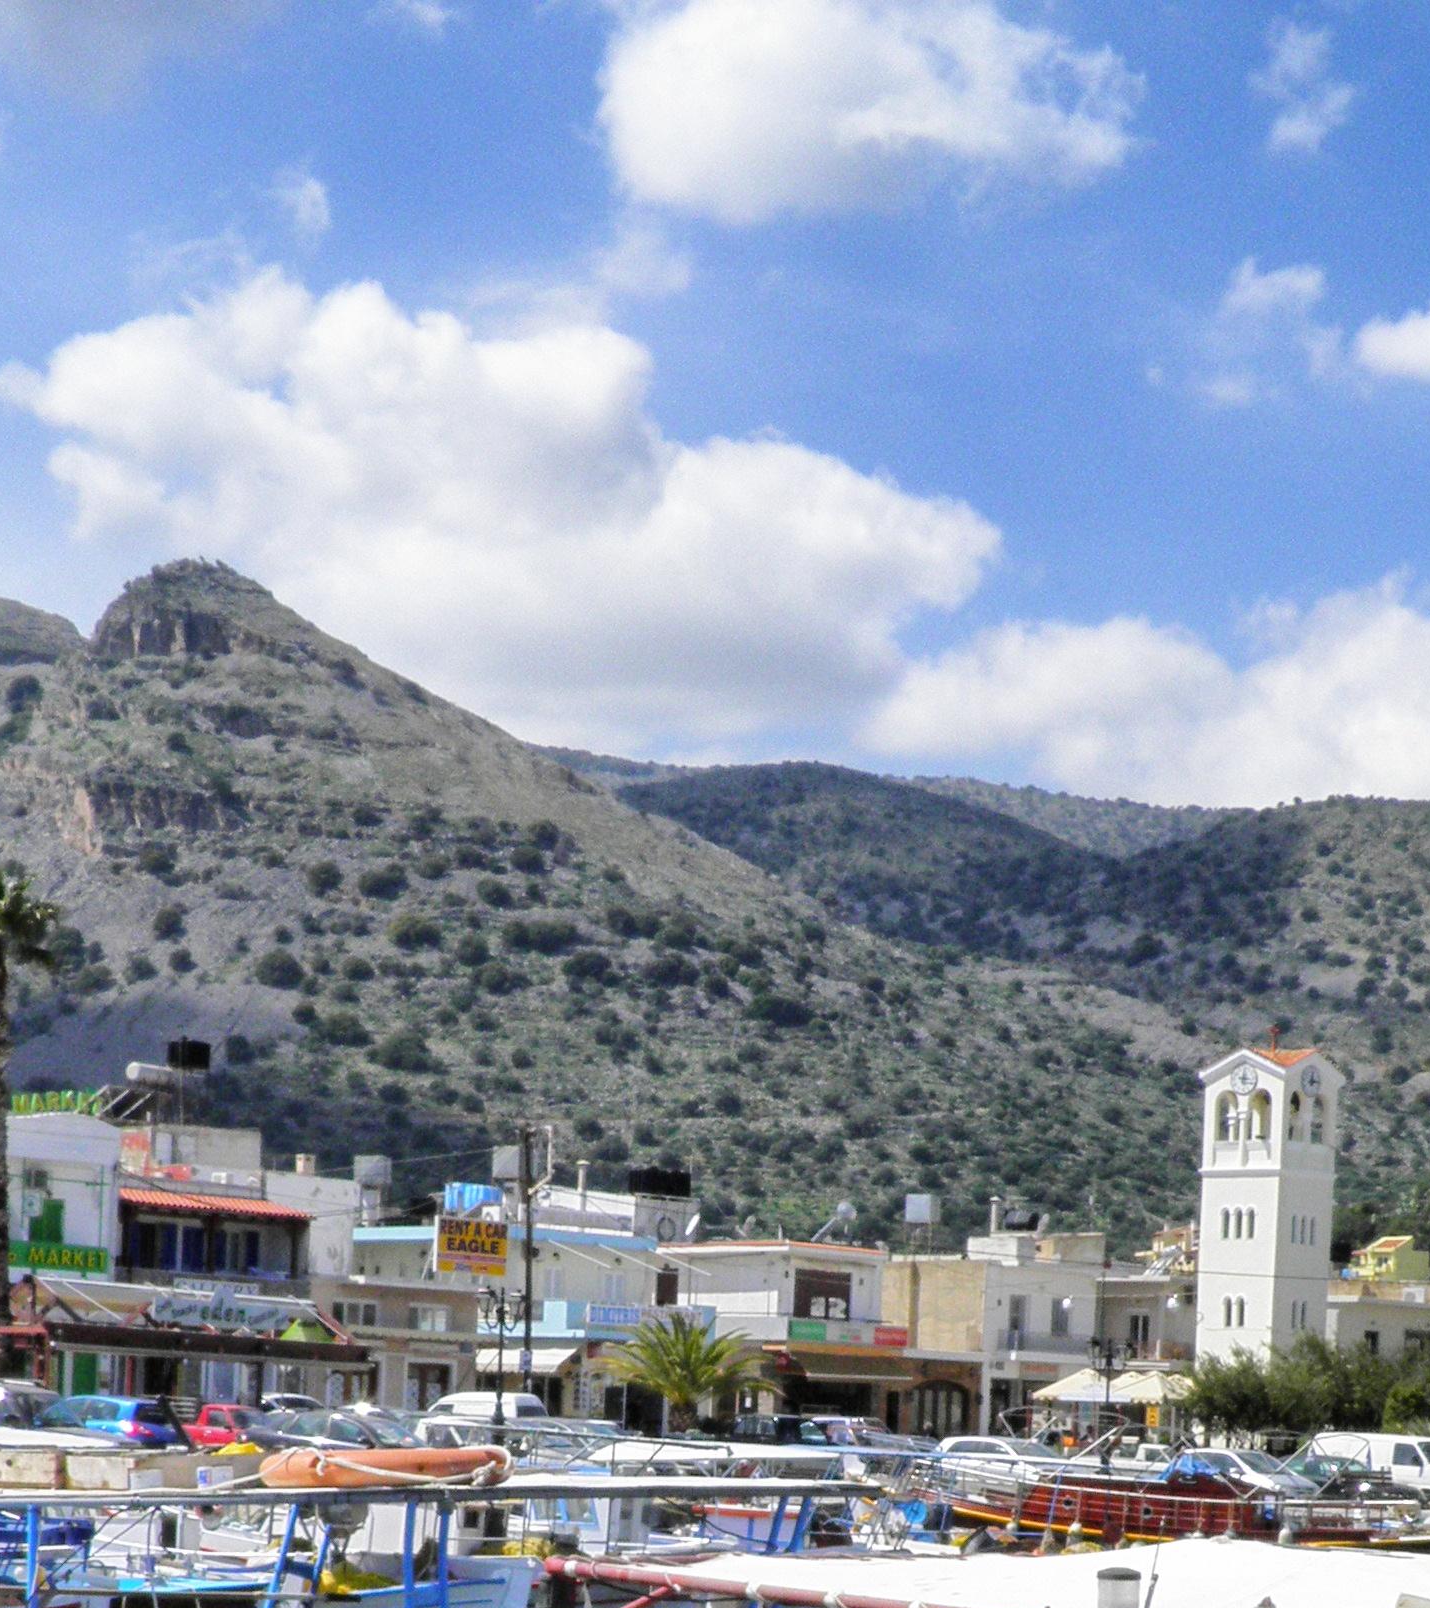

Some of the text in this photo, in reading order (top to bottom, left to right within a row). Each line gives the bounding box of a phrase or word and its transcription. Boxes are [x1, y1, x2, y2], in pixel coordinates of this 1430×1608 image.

[440, 1219, 471, 1234] RENT
[447, 1237, 499, 1255] EAGLE
[29, 1249, 106, 1272] MARKET
